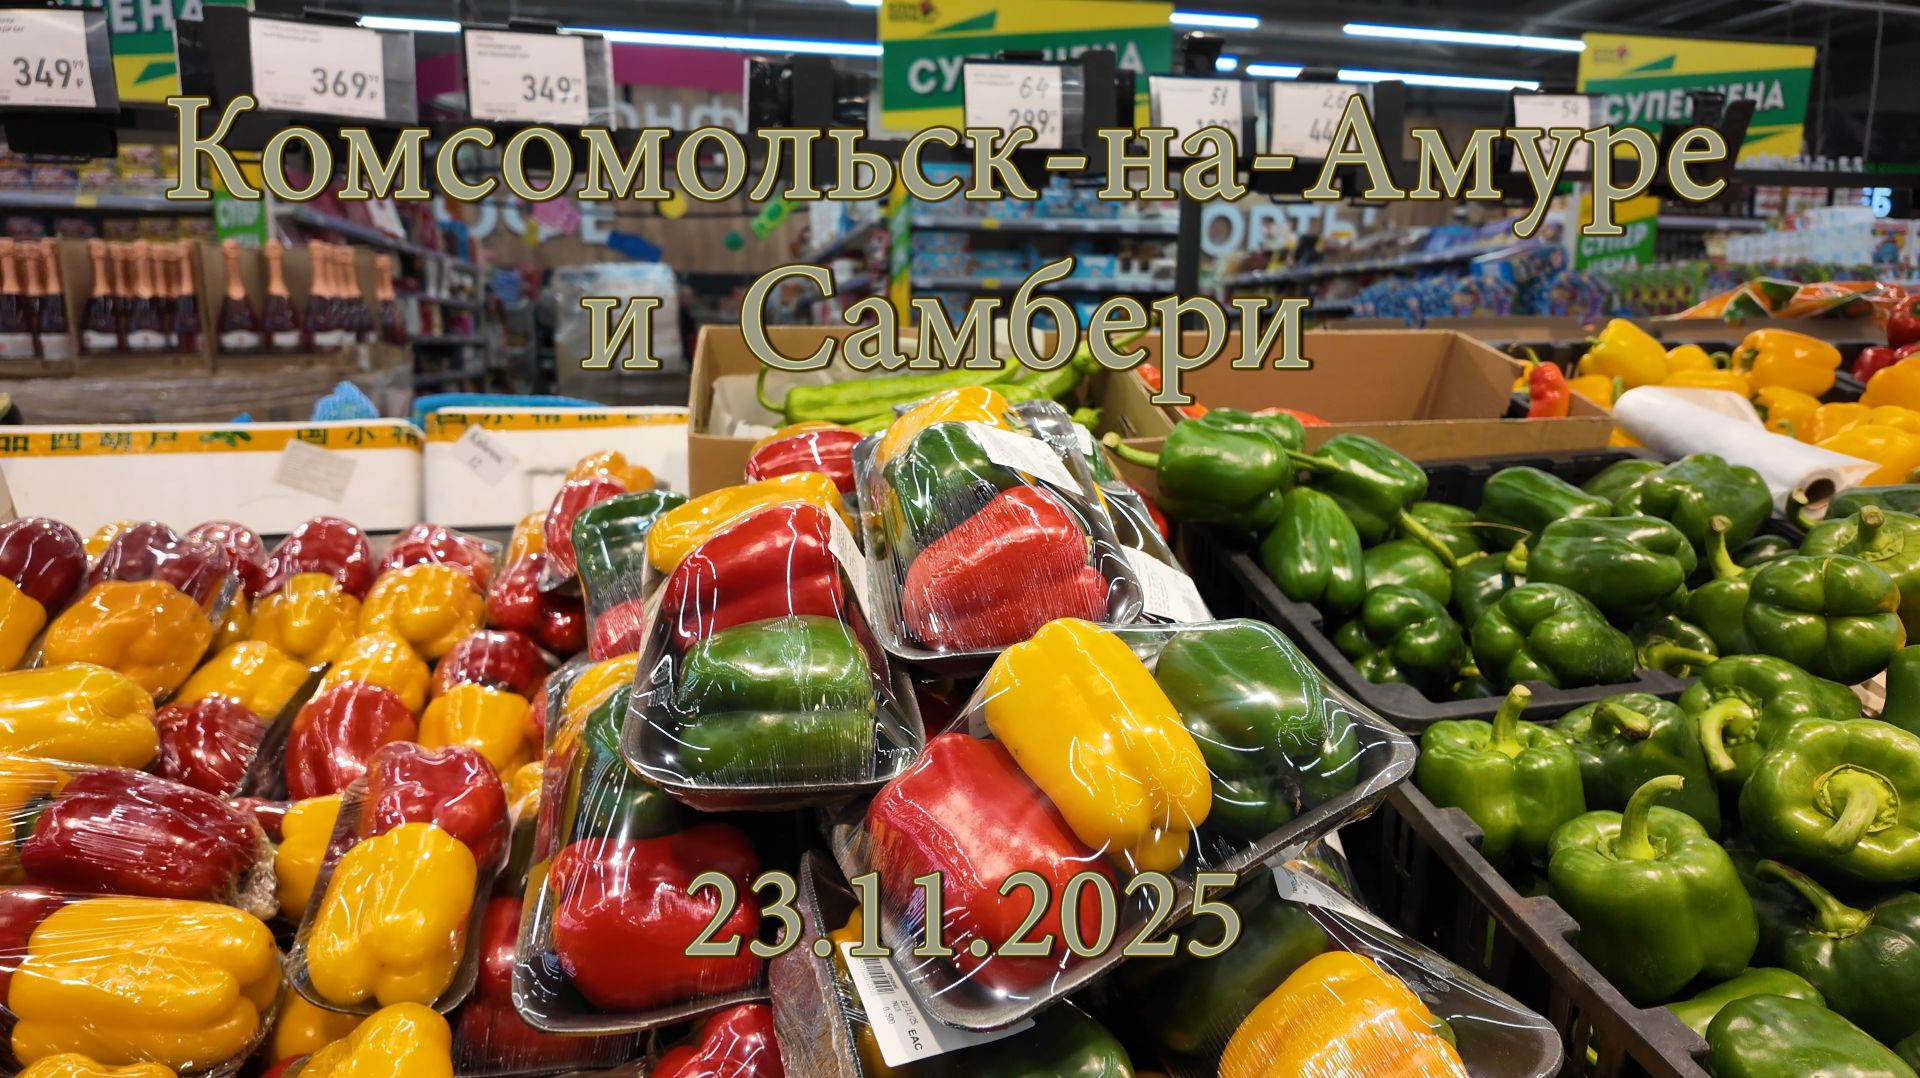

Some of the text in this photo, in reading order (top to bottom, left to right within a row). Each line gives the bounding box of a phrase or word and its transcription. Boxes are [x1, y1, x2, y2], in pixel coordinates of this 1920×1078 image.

[12, 57, 73, 89] 349
[312, 67, 367, 100] 369
[1018, 74, 1050, 100] 64
[522, 74, 571, 103] 349
[1602, 79, 1785, 124] СУПЕЕНА
[907, 1029, 923, 1051] EAC
